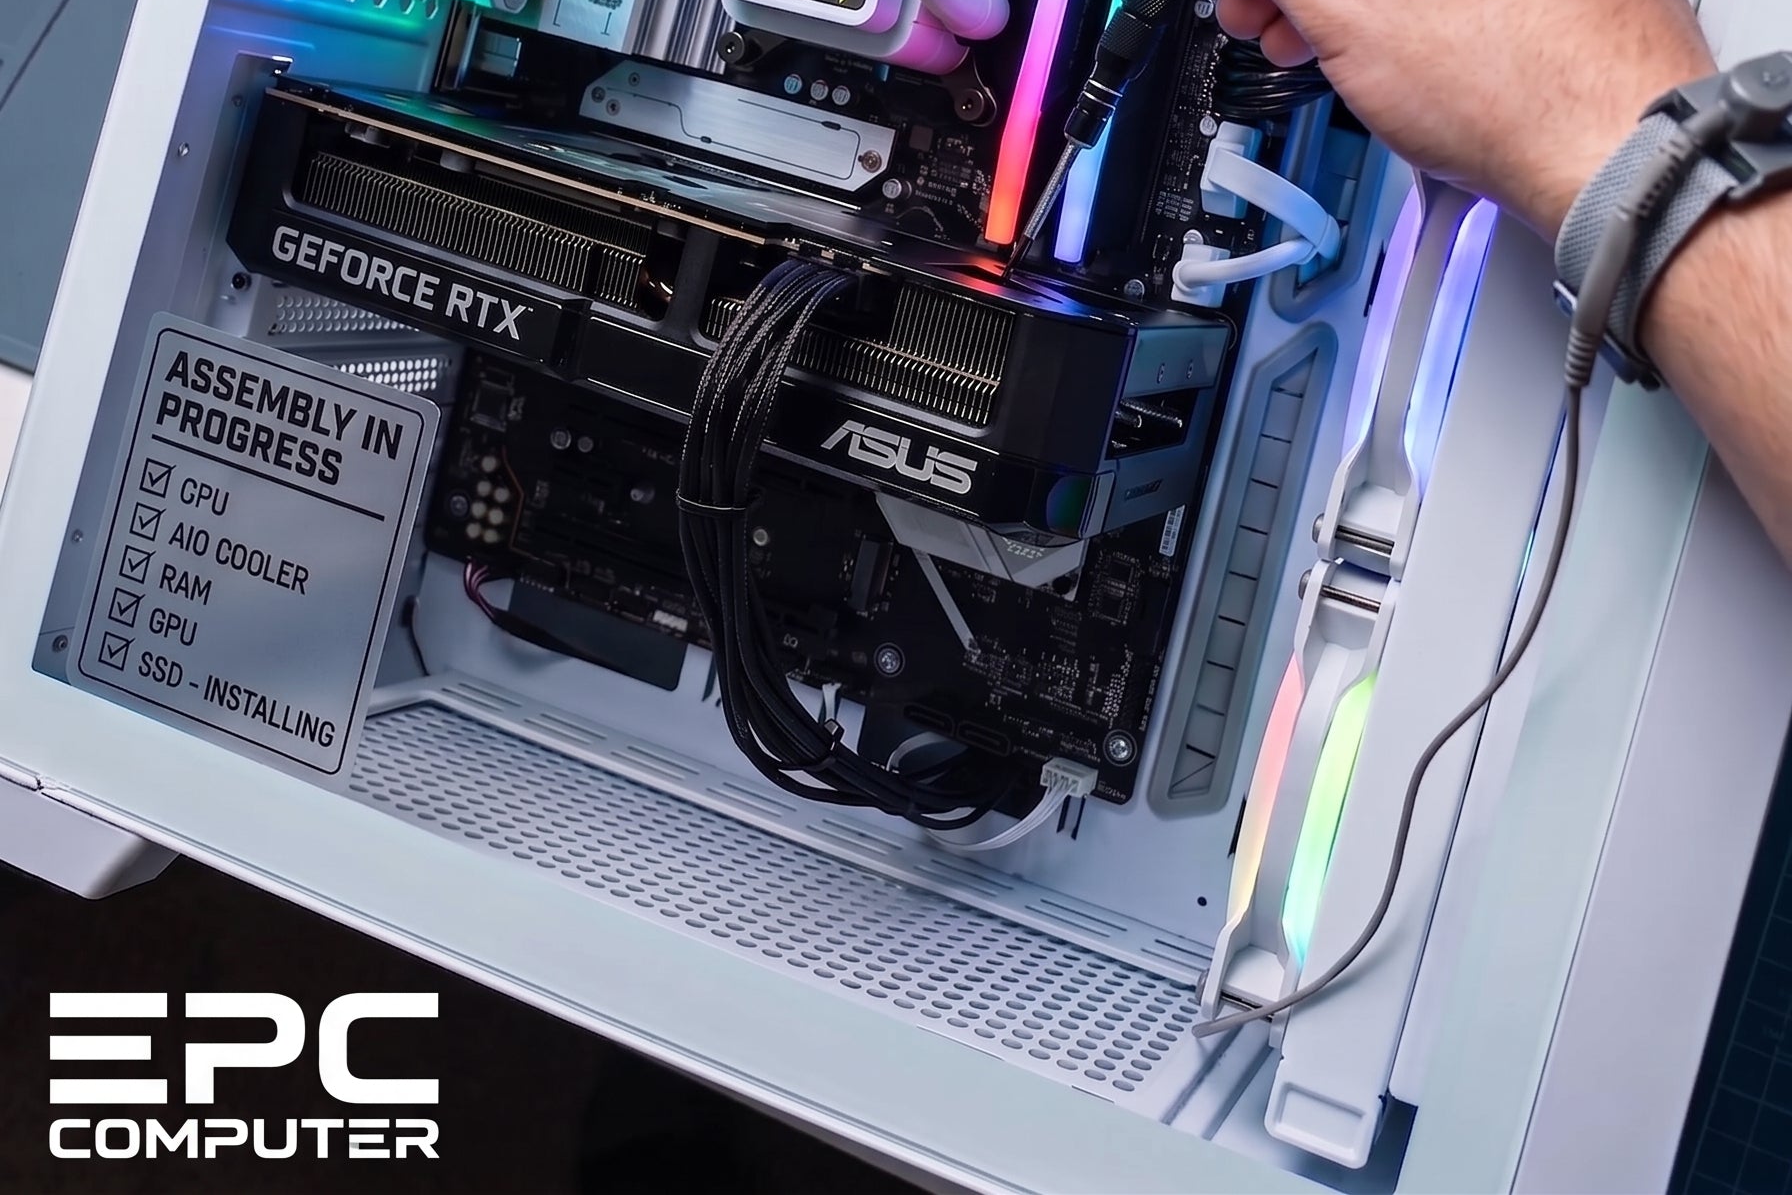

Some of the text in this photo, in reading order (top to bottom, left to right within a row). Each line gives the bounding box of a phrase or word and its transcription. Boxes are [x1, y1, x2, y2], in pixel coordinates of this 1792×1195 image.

[272, 225, 525, 341] GEFORCE RTX
[155, 391, 343, 485] PROGRESS
[165, 350, 403, 460] ASSEMBLY IN
[820, 419, 978, 495] ASUS
[159, 563, 213, 606] RAM
[168, 522, 310, 595] AIO COOLER
[149, 608, 198, 646] GPU
[138, 651, 183, 689] SSD
[203, 675, 336, 748] INSTALLING
